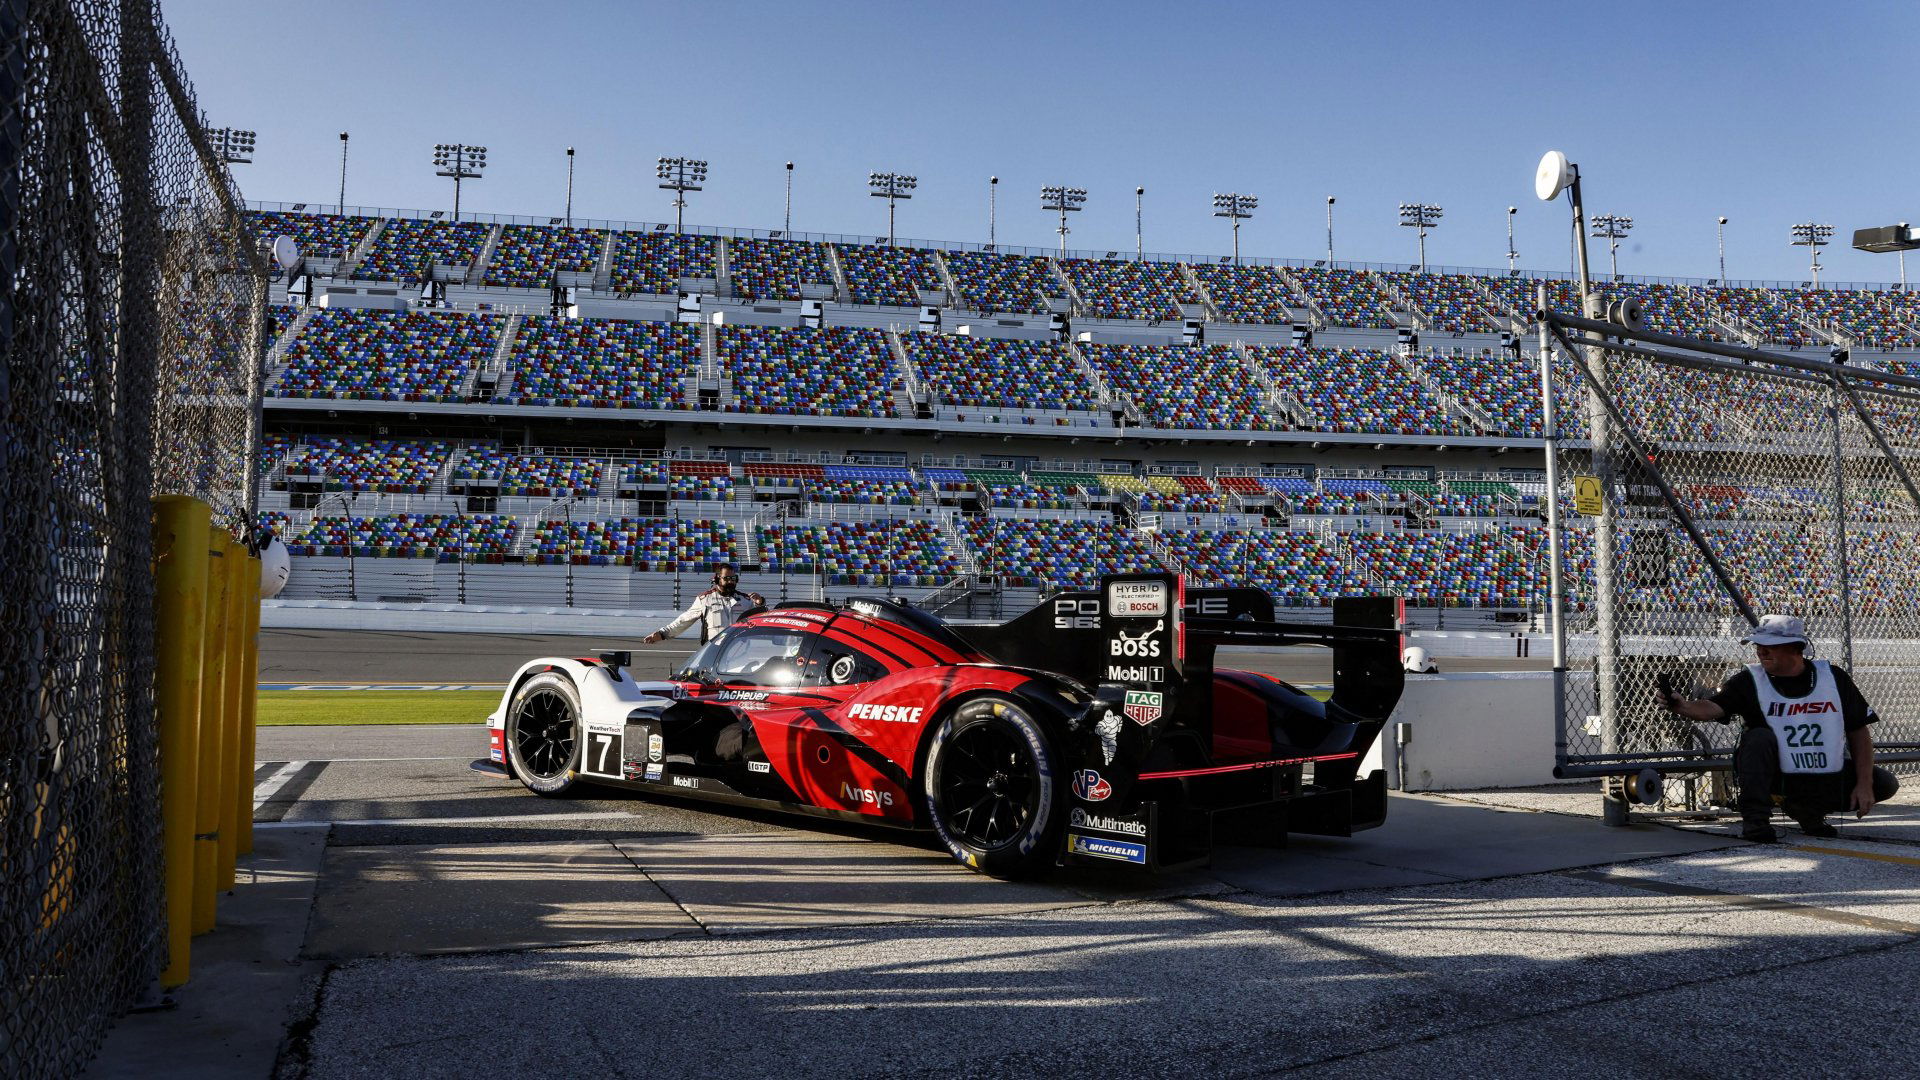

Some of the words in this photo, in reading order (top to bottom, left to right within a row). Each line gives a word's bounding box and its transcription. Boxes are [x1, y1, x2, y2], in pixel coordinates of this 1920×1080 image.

[379, 427, 388, 435] 134
[534, 448, 544, 456] 134
[663, 451, 672, 459] 133
[1116, 584, 1160, 593] HYBRID
[852, 600, 872, 613] Mobil
[1130, 602, 1158, 611] BOSCH
[1111, 639, 1160, 657] BOSS
[1108, 665, 1148, 681] Mobil
[1129, 693, 1159, 706] TAG
[847, 703, 924, 723] PENSKE
[1126, 705, 1160, 723] HEUER
[1787, 702, 1838, 716] IMSA
[589, 725, 621, 733] WeatherTech
[1783, 723, 1824, 748] 222
[1011, 714, 1048, 771] MICHELIN
[596, 734, 613, 772] 7
[754, 763, 769, 772] GTP
[1790, 752, 1828, 769] VIDEO
[673, 776, 690, 788] Mobil
[1073, 769, 1100, 800] VP
[840, 781, 893, 809] Ansys
[1086, 814, 1146, 834] Multimatic
[1089, 843, 1139, 857] MICHELIN
